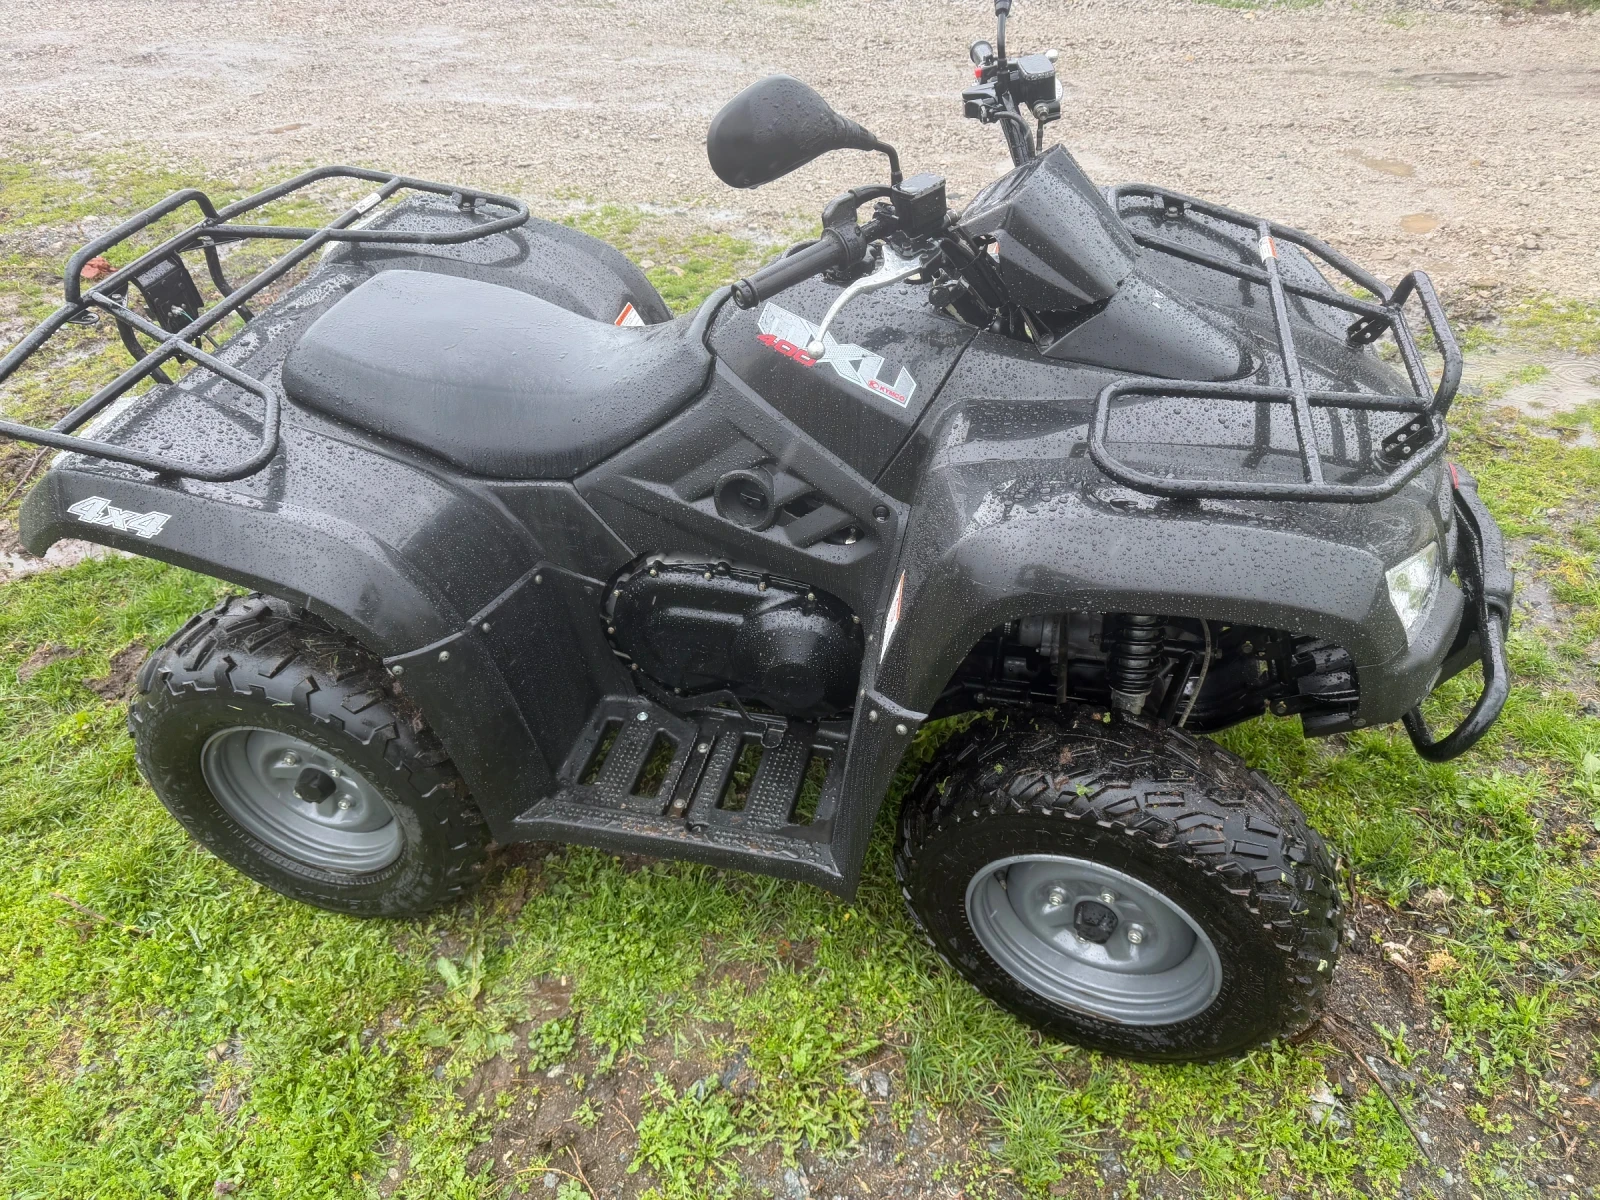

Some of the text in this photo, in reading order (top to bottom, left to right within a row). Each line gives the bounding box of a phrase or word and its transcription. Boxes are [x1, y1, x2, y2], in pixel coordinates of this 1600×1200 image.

[756, 334, 818, 367] 400
[879, 385, 906, 403] KYMCO
[67, 495, 172, 539] 4x4
